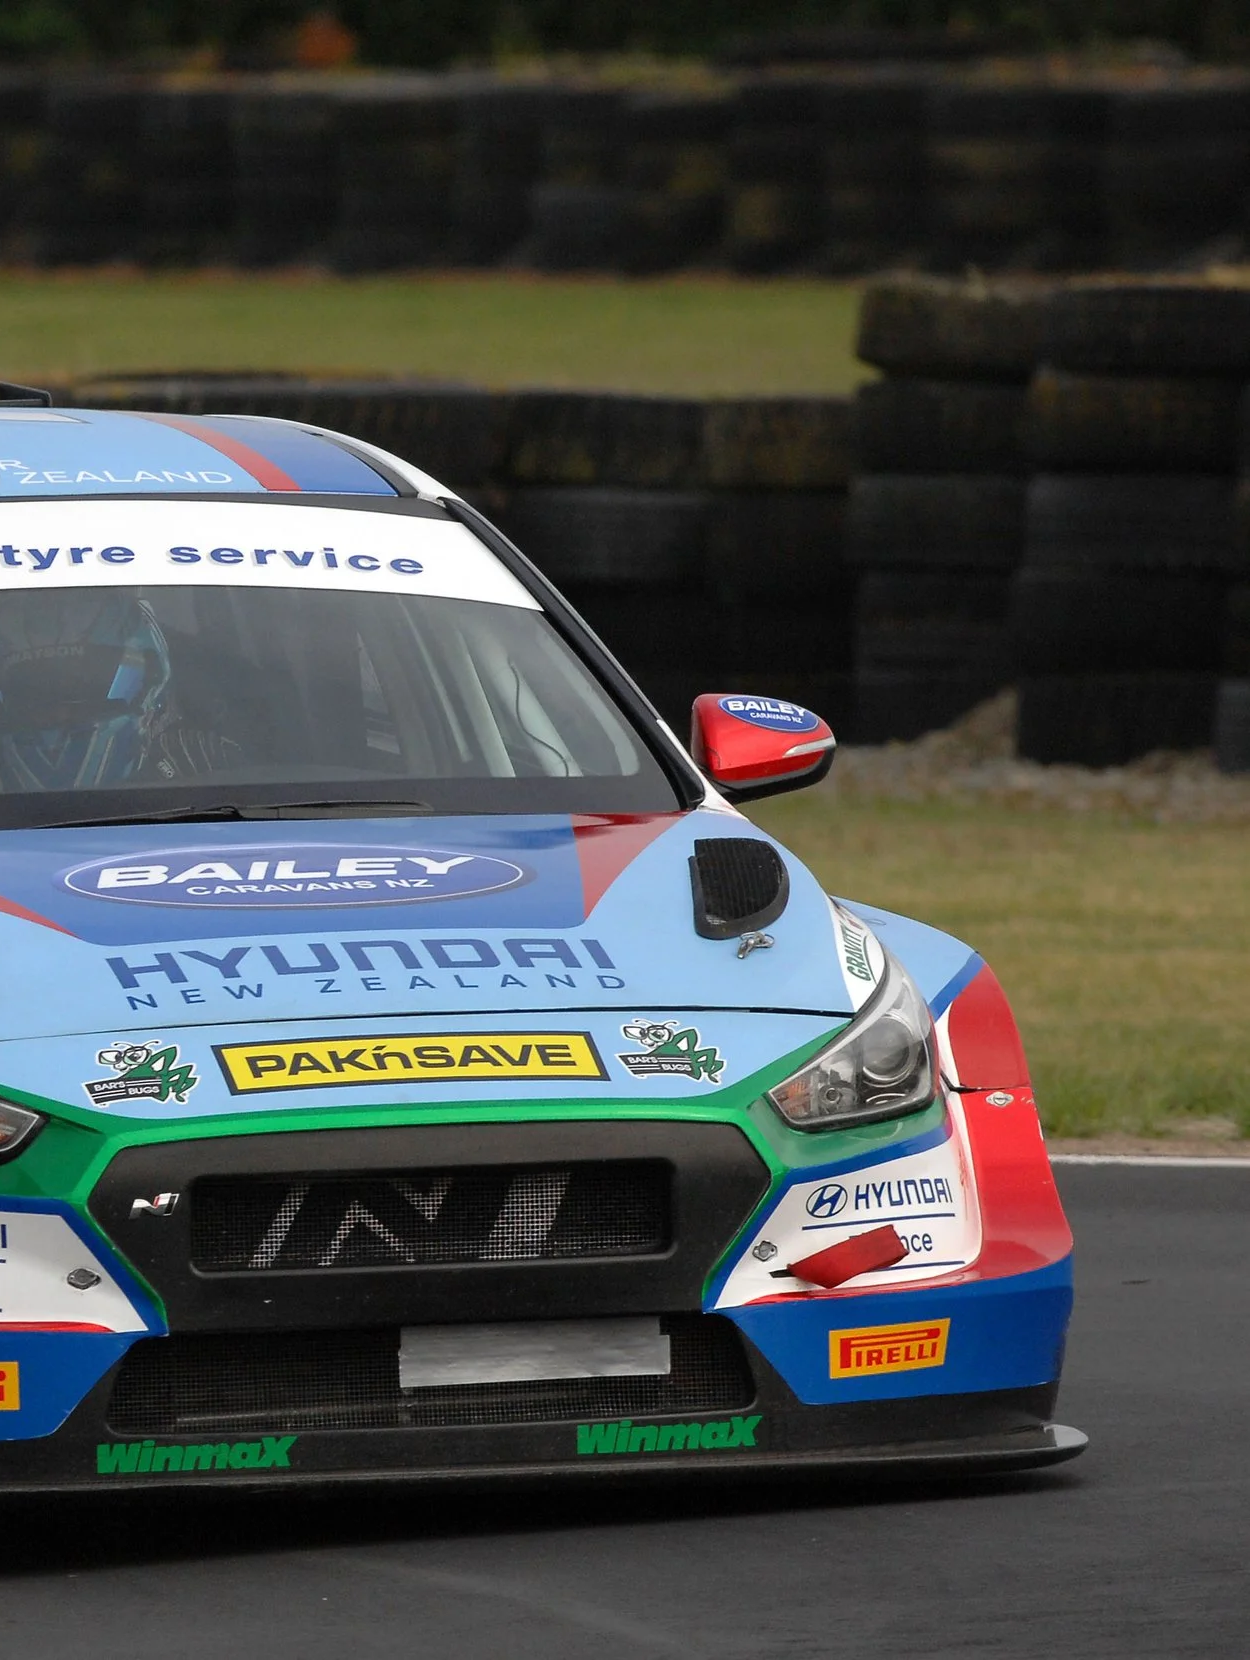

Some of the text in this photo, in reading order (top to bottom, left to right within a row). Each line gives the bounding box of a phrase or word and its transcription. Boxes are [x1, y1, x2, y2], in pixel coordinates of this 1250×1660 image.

[13, 470, 234, 486] ZEALAND
[168, 543, 426, 576] service
[726, 700, 807, 717] BAILEY
[96, 855, 478, 890] BAILEY
[186, 877, 436, 896] CARAVANS NZ
[105, 937, 619, 990] HYUNDAI
[125, 973, 628, 1012] NEW ZEALAND
[660, 1063, 692, 1071] BUGS
[93, 1081, 126, 1092] BAR'S
[127, 1085, 160, 1095] BUGS
[854, 1177, 953, 1211] HYUNDAI
[839, 1327, 942, 1369] PIRELLI
